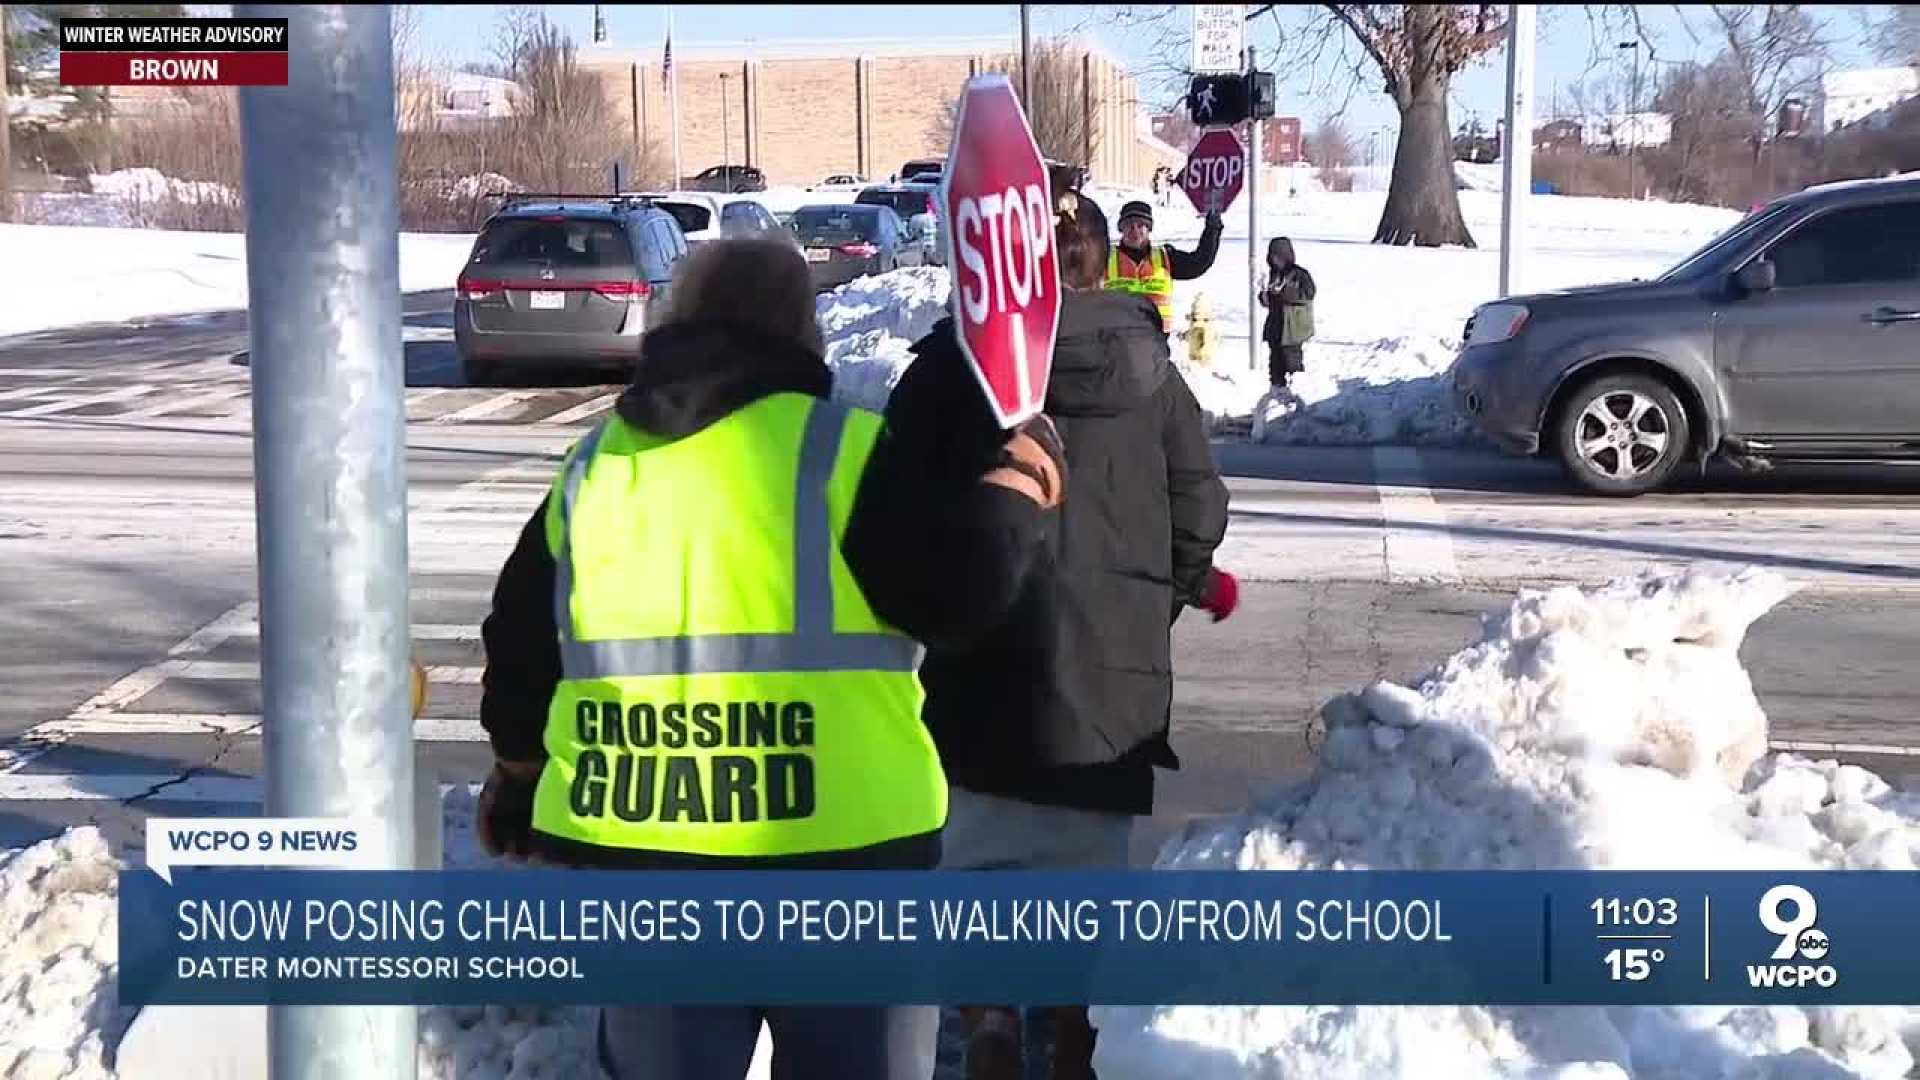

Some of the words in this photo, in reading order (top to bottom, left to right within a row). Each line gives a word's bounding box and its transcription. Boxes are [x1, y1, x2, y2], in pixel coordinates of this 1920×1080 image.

[1197, 19, 1239, 31] BUTTON
[1207, 31, 1229, 41] FOR
[1202, 43, 1232, 54] WALK
[1201, 55, 1232, 66] LIGHT
[1188, 155, 1242, 190] STOP
[957, 183, 1049, 325] STOP
[576, 699, 815, 750] CROSSING
[570, 749, 816, 823] GUARD
